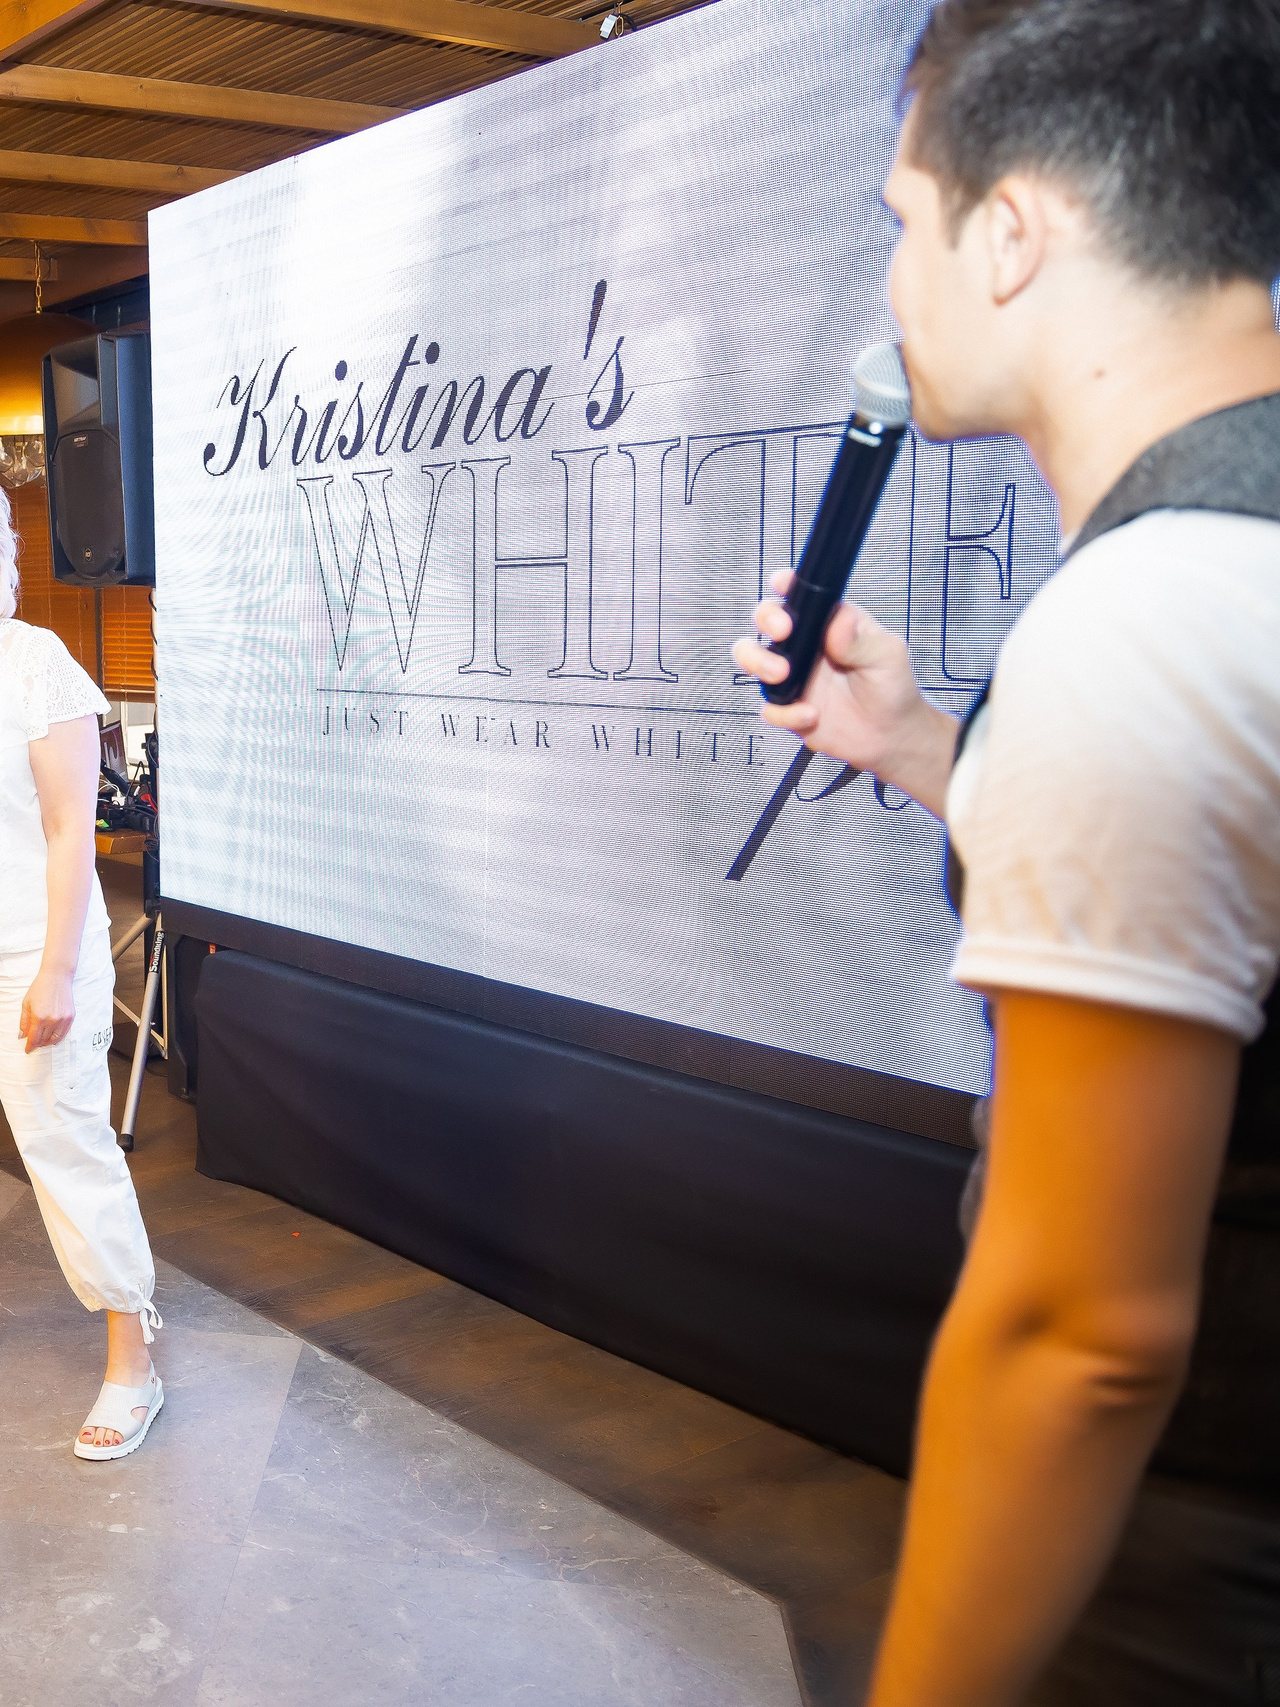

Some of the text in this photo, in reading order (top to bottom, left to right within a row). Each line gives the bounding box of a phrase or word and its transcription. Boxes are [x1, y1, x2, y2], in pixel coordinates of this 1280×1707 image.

[322, 705, 766, 766] JUST WEAR WHITE
